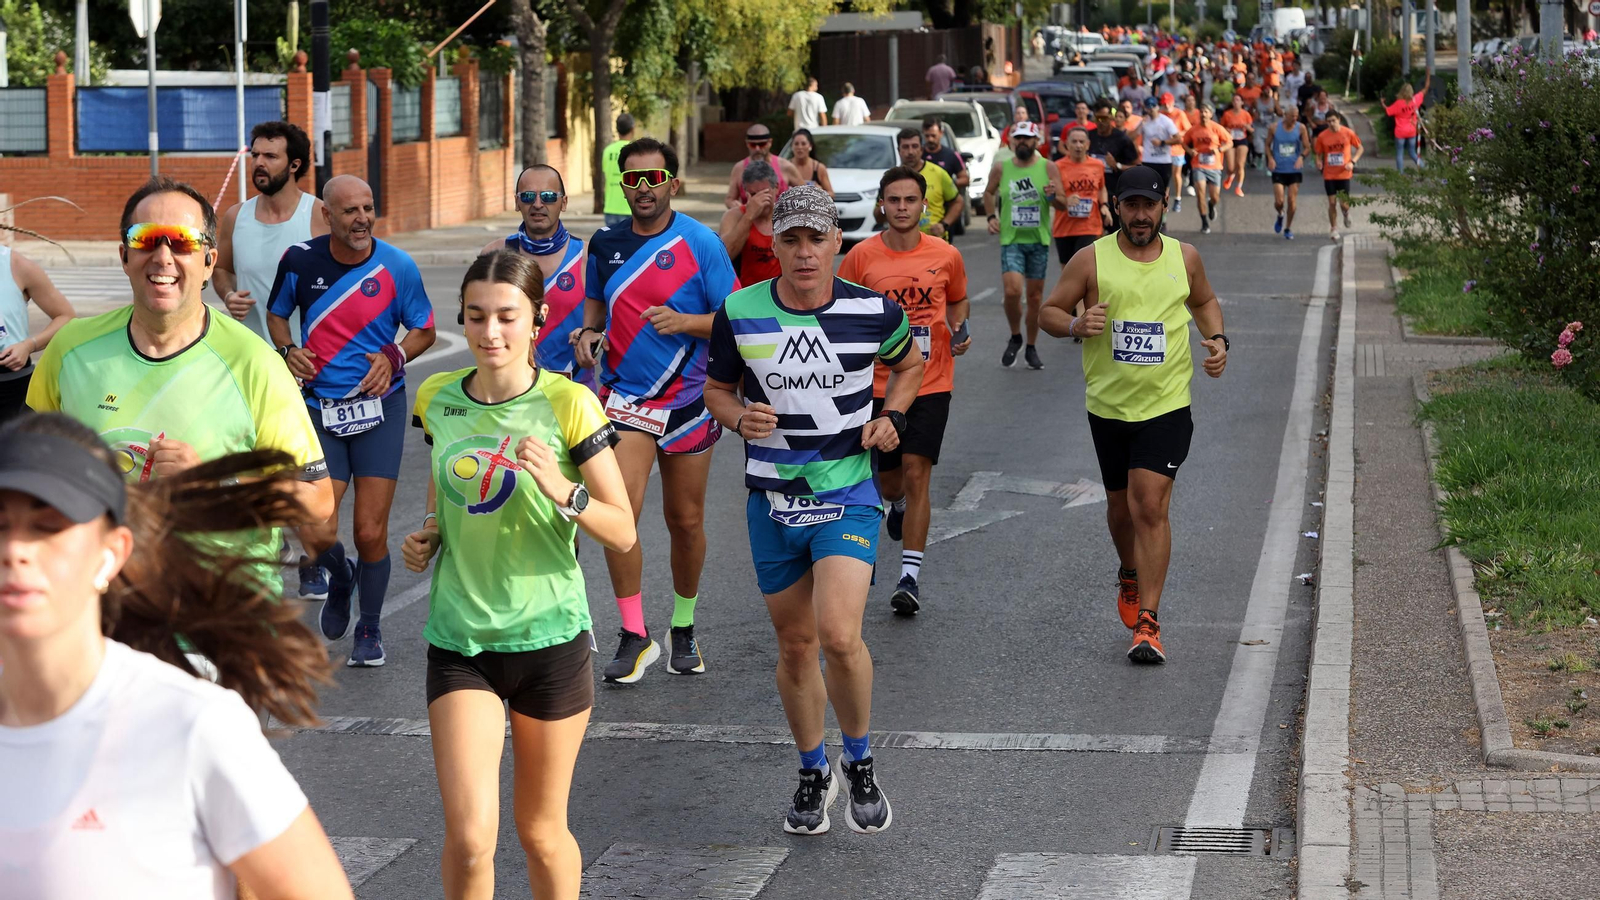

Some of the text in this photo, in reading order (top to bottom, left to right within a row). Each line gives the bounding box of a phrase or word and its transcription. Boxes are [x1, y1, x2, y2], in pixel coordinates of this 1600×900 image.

[1018, 213, 1034, 221] 732
[1124, 335, 1153, 351] 994
[337, 403, 366, 422] 811
